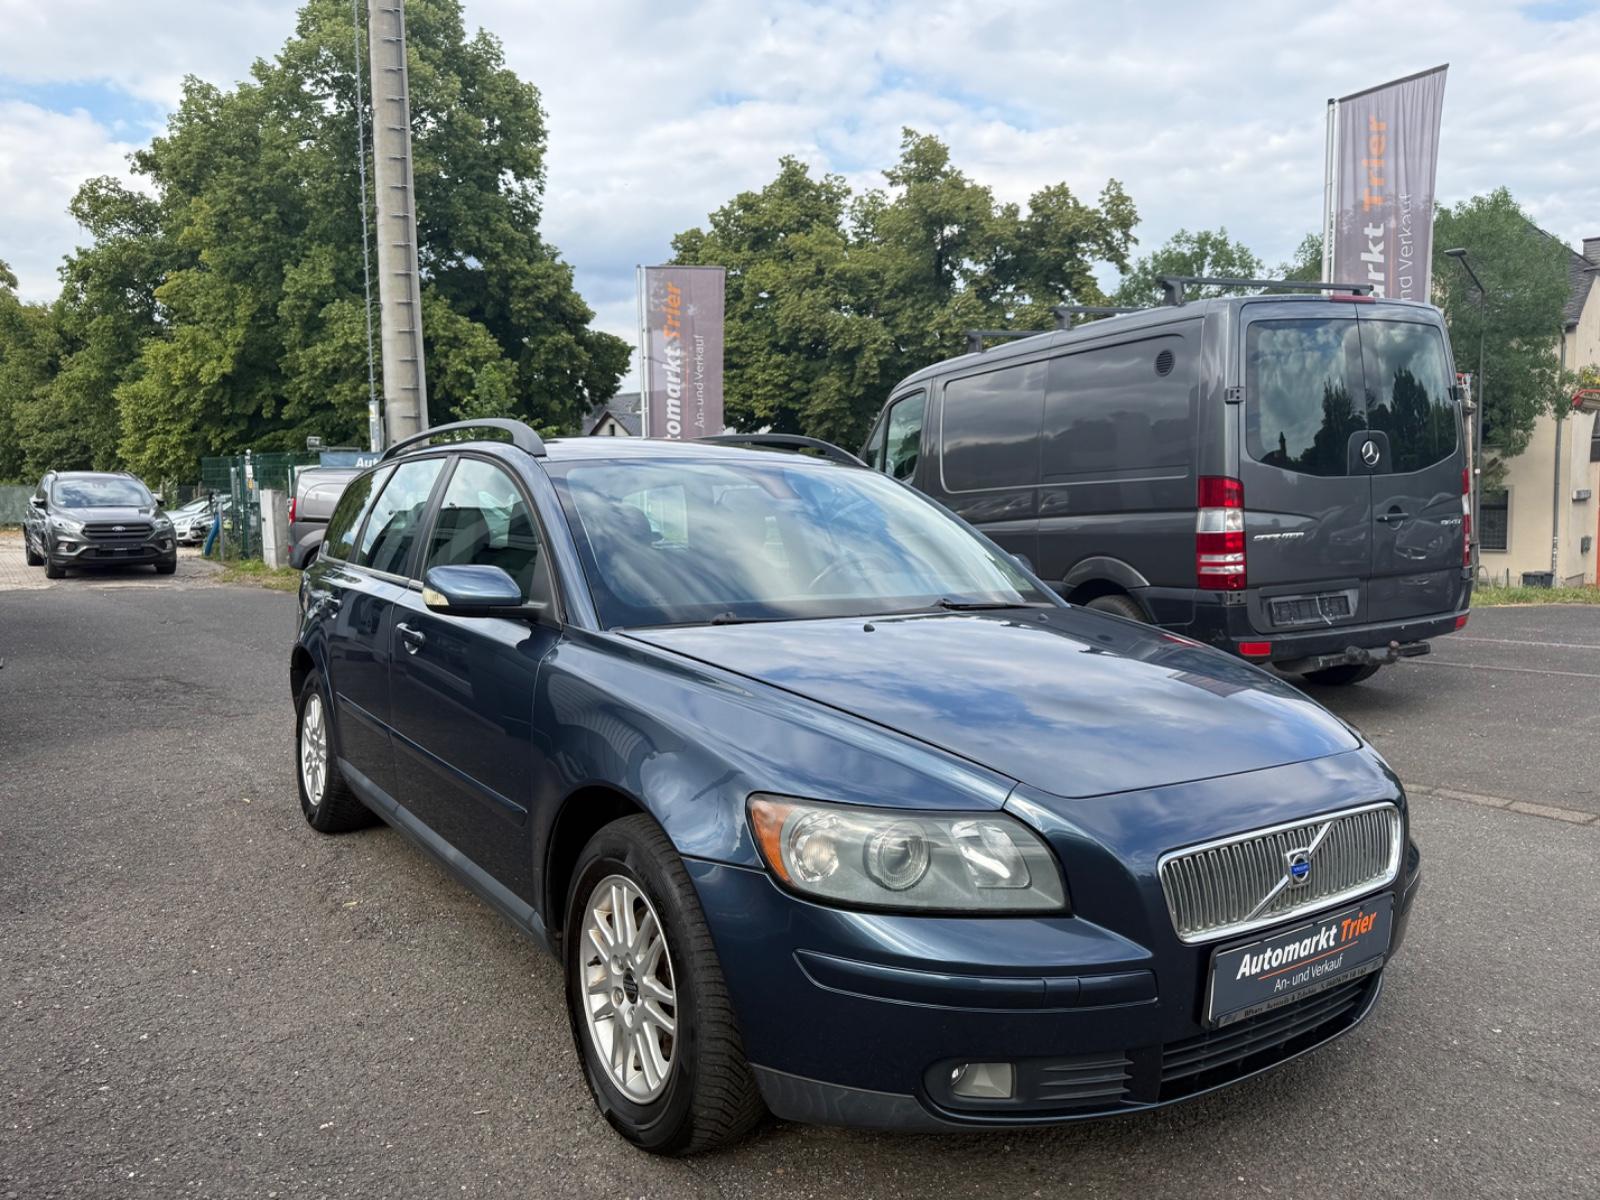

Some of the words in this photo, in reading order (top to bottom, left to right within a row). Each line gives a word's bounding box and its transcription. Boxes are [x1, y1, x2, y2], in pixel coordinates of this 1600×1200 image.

[1361, 114, 1388, 214] Trier
[1360, 222, 1385, 299] arkt
[1398, 193, 1413, 272] Verkauf
[662, 281, 681, 338] Trier
[1398, 276, 1413, 300] nd
[693, 335, 705, 380] Verkauf
[662, 346, 681, 440] tomarkt
[693, 382, 705, 406] und
[693, 408, 705, 429] An-
[1236, 925, 1338, 980] Automarkt
[1341, 911, 1377, 942] Trier
[1274, 979, 1290, 993] An-
[1292, 965, 1311, 986] und
[1311, 953, 1344, 978] Verkauf
